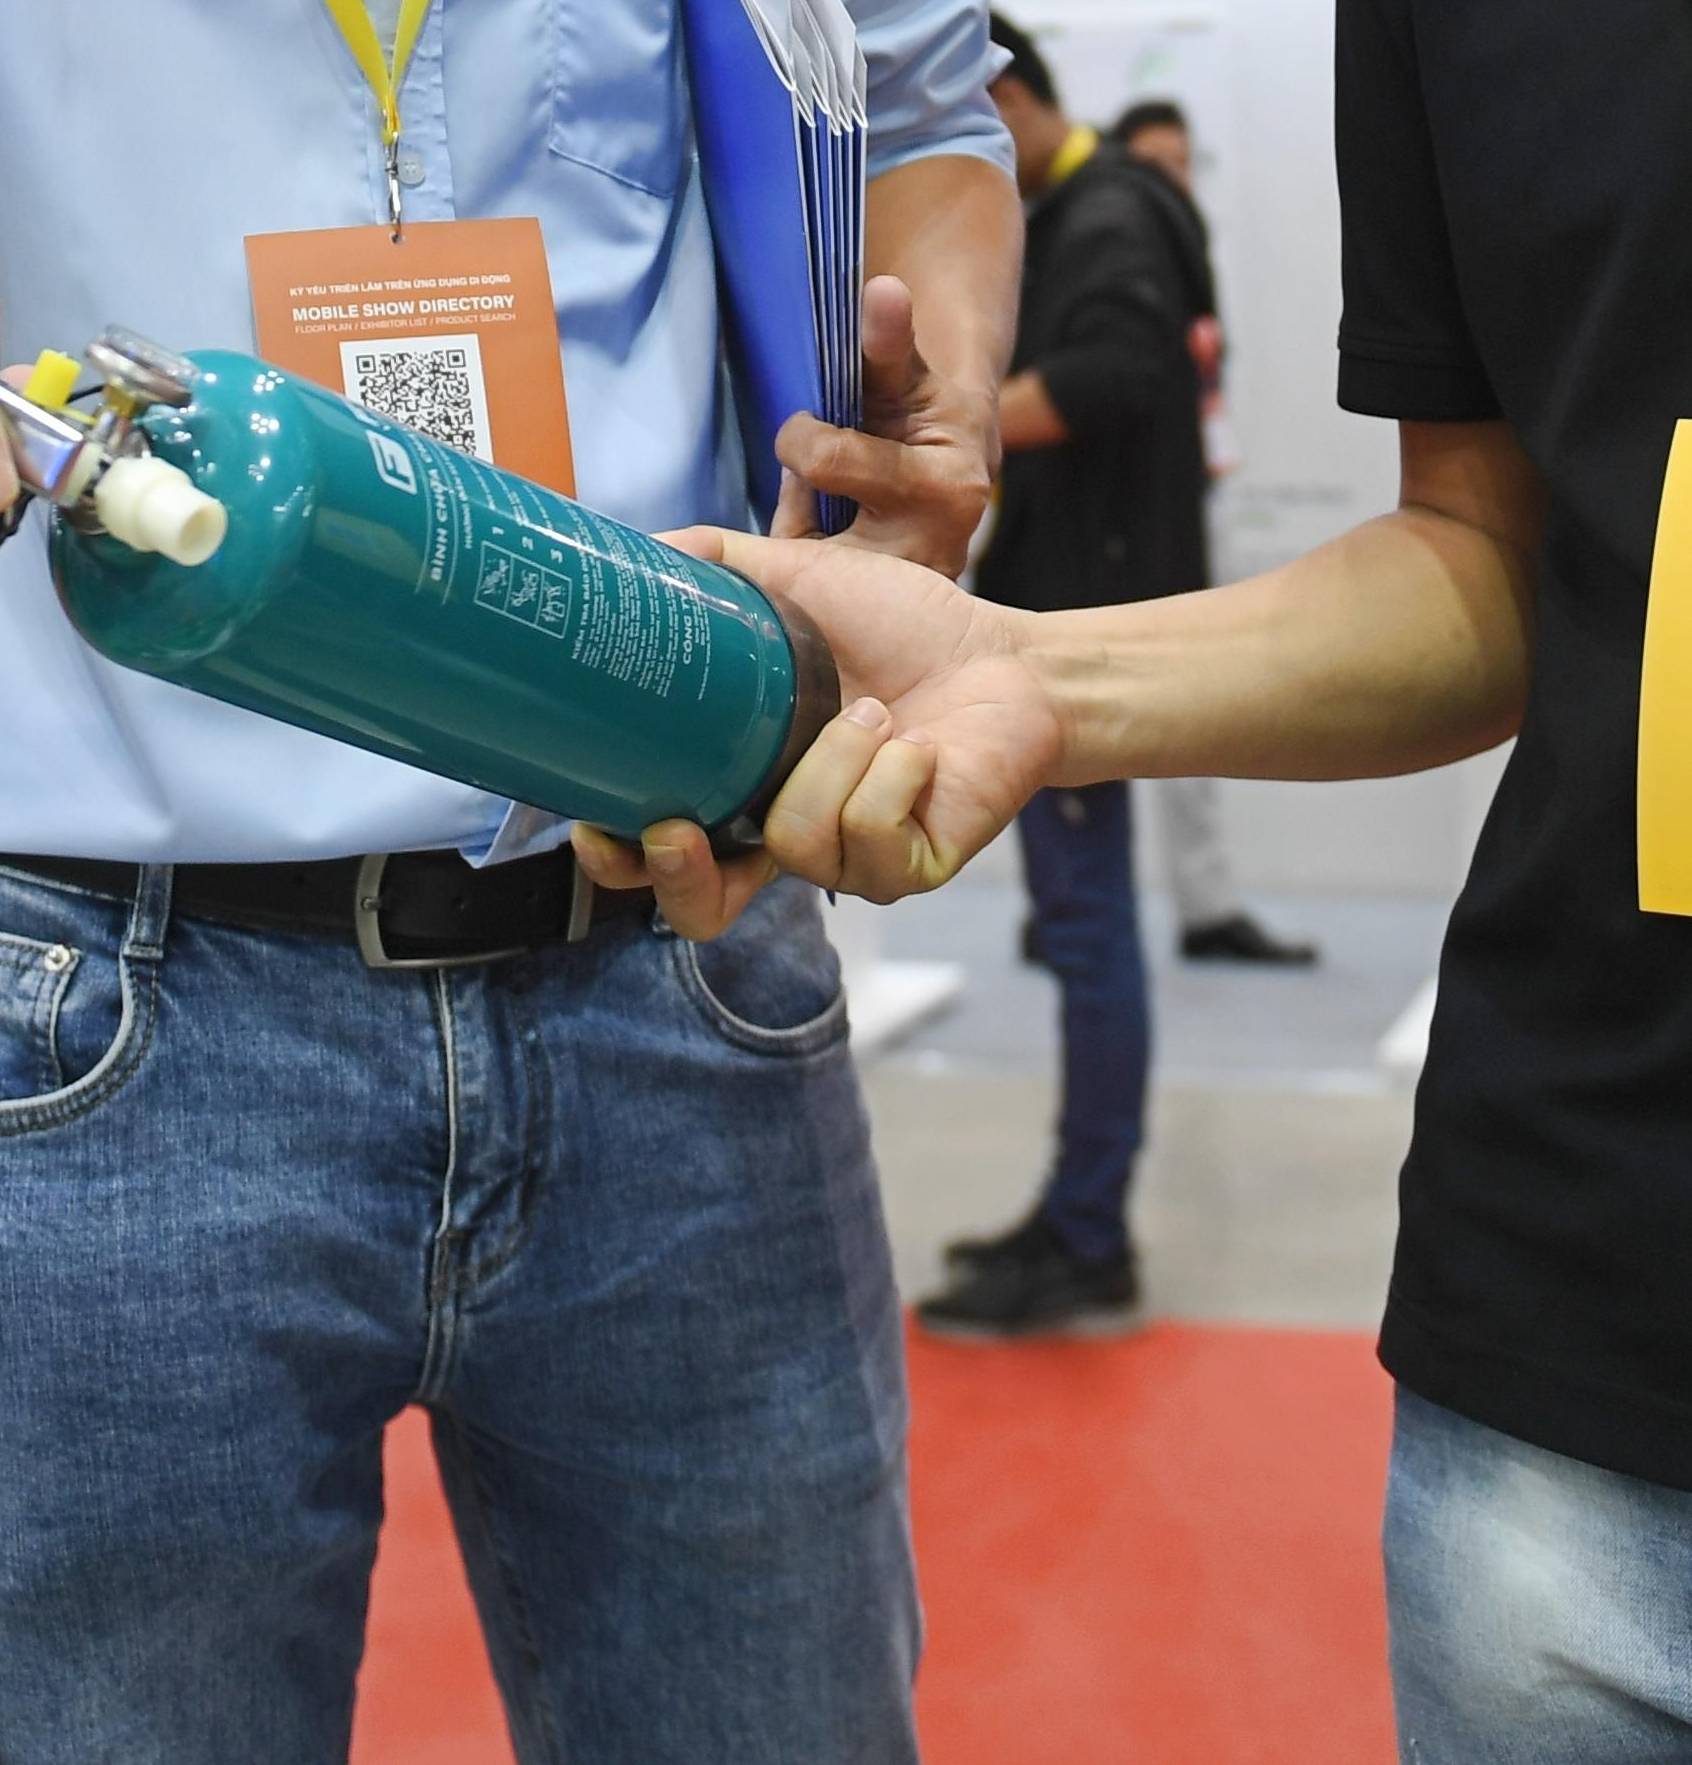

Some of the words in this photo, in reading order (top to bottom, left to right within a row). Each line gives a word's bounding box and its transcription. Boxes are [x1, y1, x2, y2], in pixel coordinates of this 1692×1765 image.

[292, 304, 360, 321] MOBILE
[363, 300, 415, 318] SHOW
[419, 295, 515, 314] DIRECTORY
[295, 322, 326, 334] FLOOR
[328, 320, 352, 332] PLAN
[361, 317, 408, 330] EXHIBITOR
[410, 316, 428, 327] LIST
[435, 313, 478, 326] PRODUCT
[480, 311, 516, 323] SEARCH
[521, 536, 534, 550] 2
